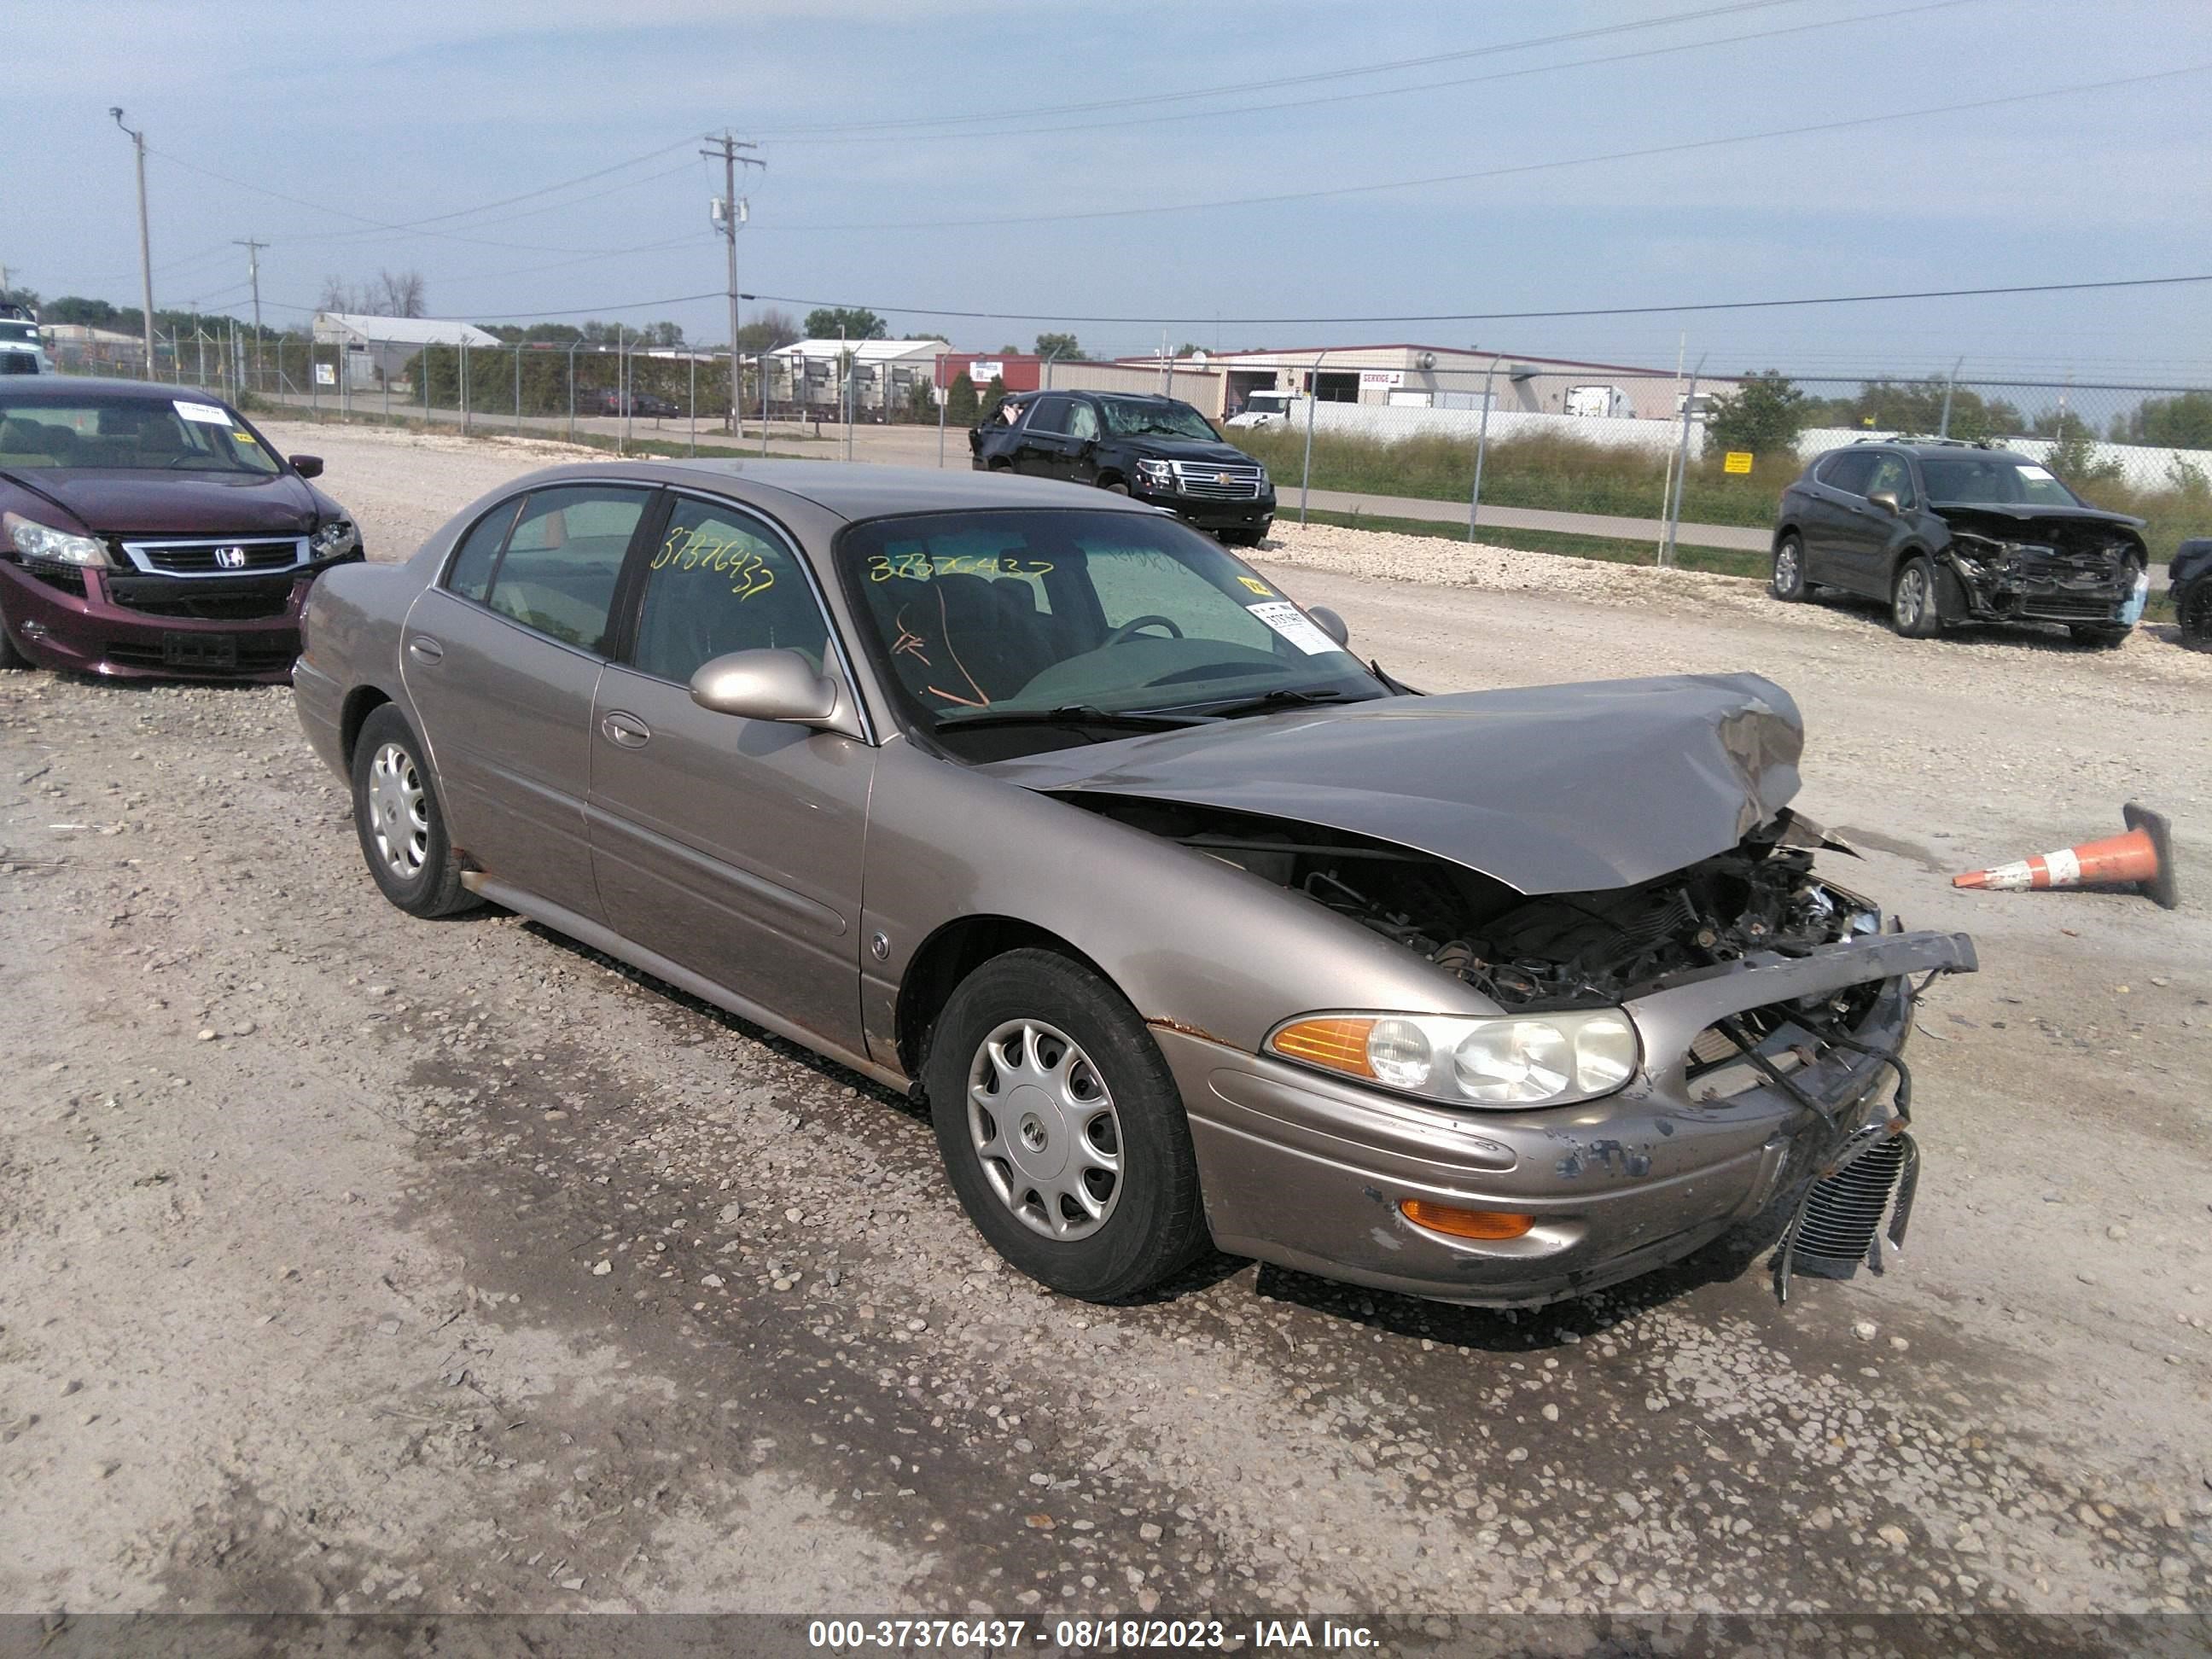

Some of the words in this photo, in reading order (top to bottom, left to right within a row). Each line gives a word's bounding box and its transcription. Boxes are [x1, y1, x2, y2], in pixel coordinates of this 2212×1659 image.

[1363, 374, 1389, 383] SERVICE
[649, 526, 775, 602] 37376437
[867, 552, 1055, 583] 37376437
